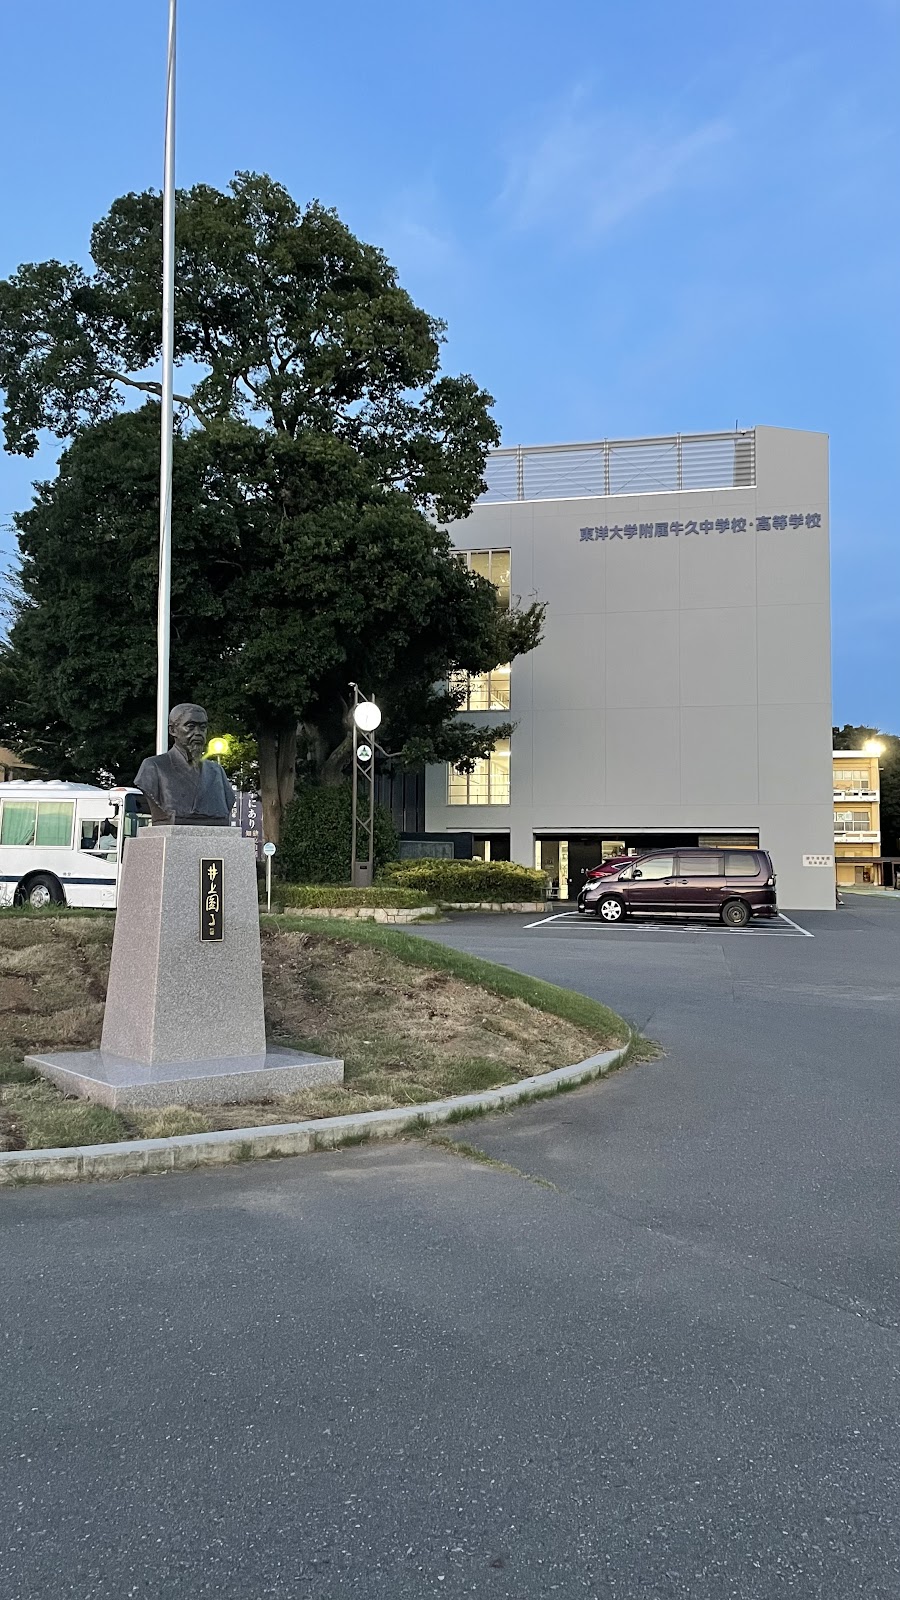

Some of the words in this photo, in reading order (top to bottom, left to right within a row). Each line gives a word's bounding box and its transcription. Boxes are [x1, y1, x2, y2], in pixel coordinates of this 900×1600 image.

[580, 513, 822, 542] 東洋大学附属牛久中学校・高等学校
